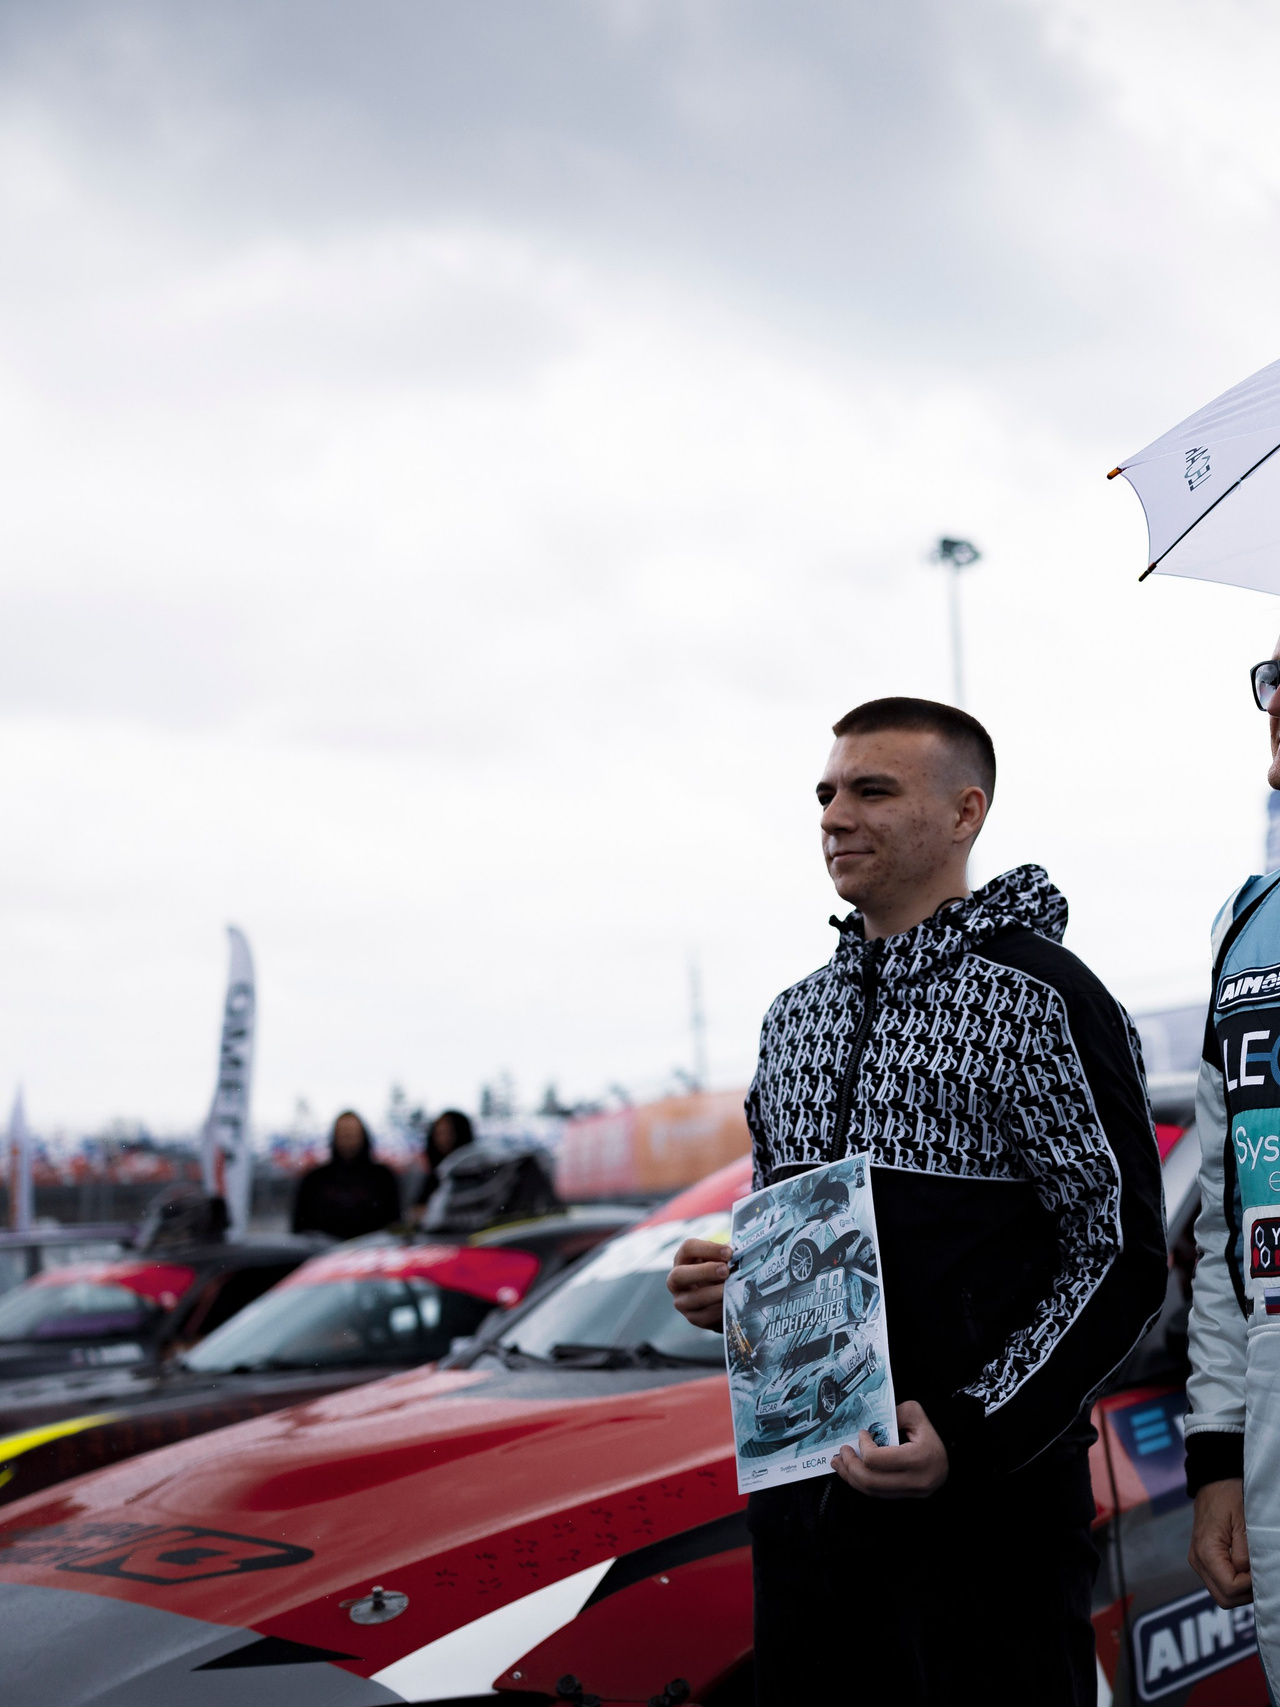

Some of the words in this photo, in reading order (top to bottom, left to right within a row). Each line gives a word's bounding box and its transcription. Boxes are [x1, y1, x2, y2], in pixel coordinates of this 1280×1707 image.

[765, 1256, 786, 1278] LECAR
[816, 1267, 845, 1304] 88
[766, 1300, 844, 1342] ЦАРЕГРАДЦЕВ
[760, 1403, 778, 1414] LECAR
[802, 1457, 827, 1470] LECAR
